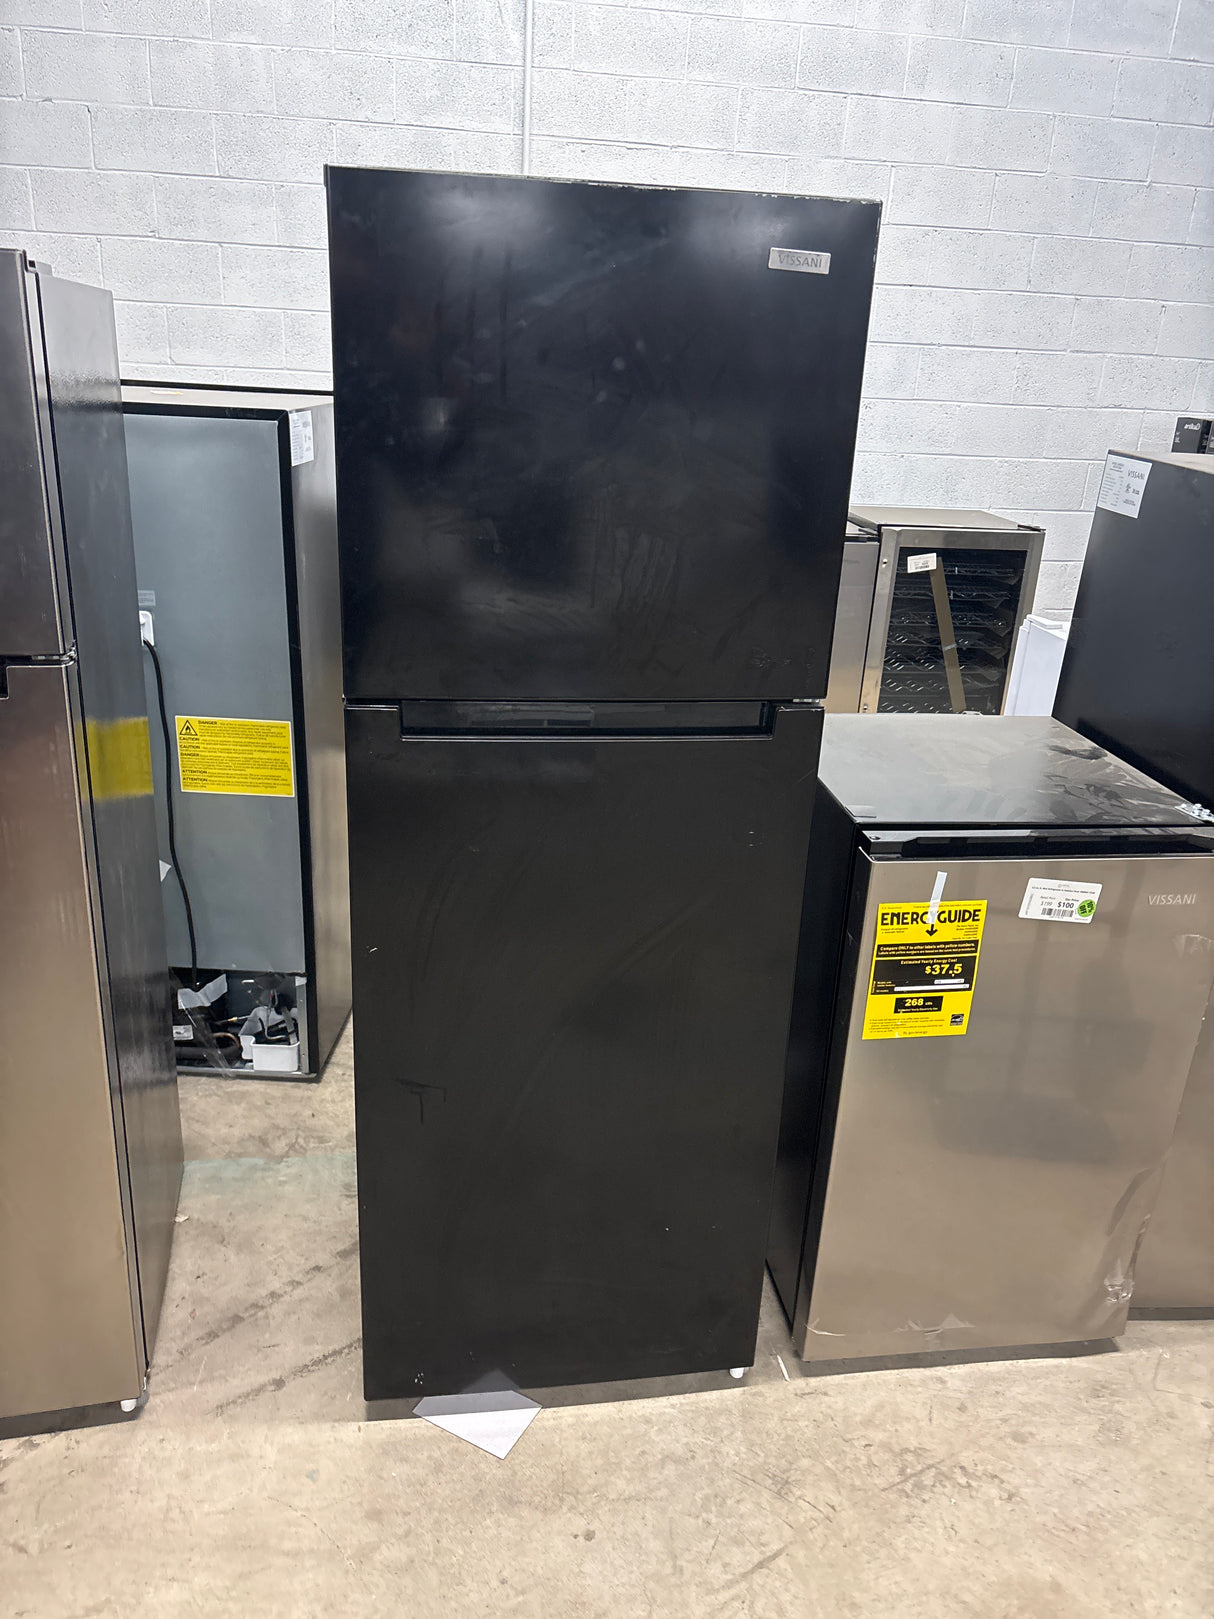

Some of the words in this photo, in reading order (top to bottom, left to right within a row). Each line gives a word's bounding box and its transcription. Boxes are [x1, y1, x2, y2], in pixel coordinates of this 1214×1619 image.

[778, 253, 823, 268] VISSANI
[1057, 901, 1075, 909] $100
[1148, 894, 1197, 905] VISSANI
[925, 964, 963, 975] $37.5
[904, 998, 924, 1007] 268
